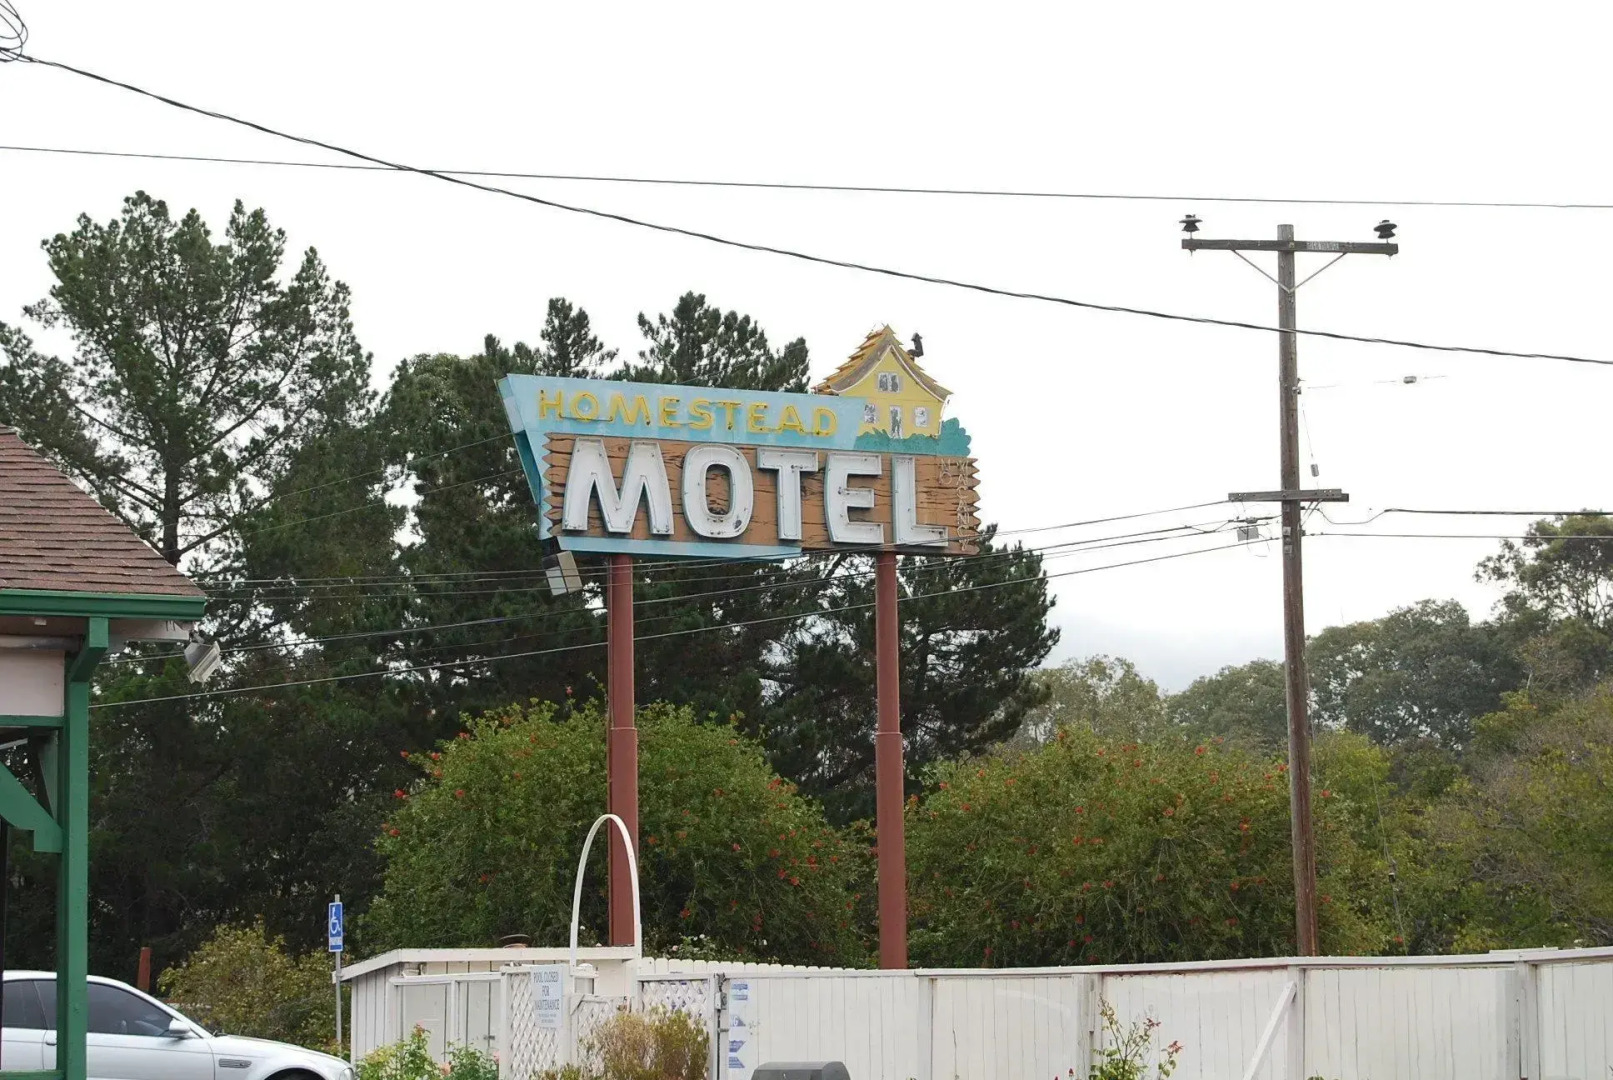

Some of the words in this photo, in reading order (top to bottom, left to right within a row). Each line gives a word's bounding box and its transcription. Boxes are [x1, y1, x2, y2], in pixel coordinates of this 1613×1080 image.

[538, 389, 838, 437] HOMESTEAD
[562, 437, 949, 548] MOTEL
[956, 458, 970, 551] VACANCY
[533, 971, 543, 983] POOL
[544, 971, 559, 983] CLOSED
[541, 985, 550, 997] FOR
[533, 998, 560, 1011] MAINTENANCE
